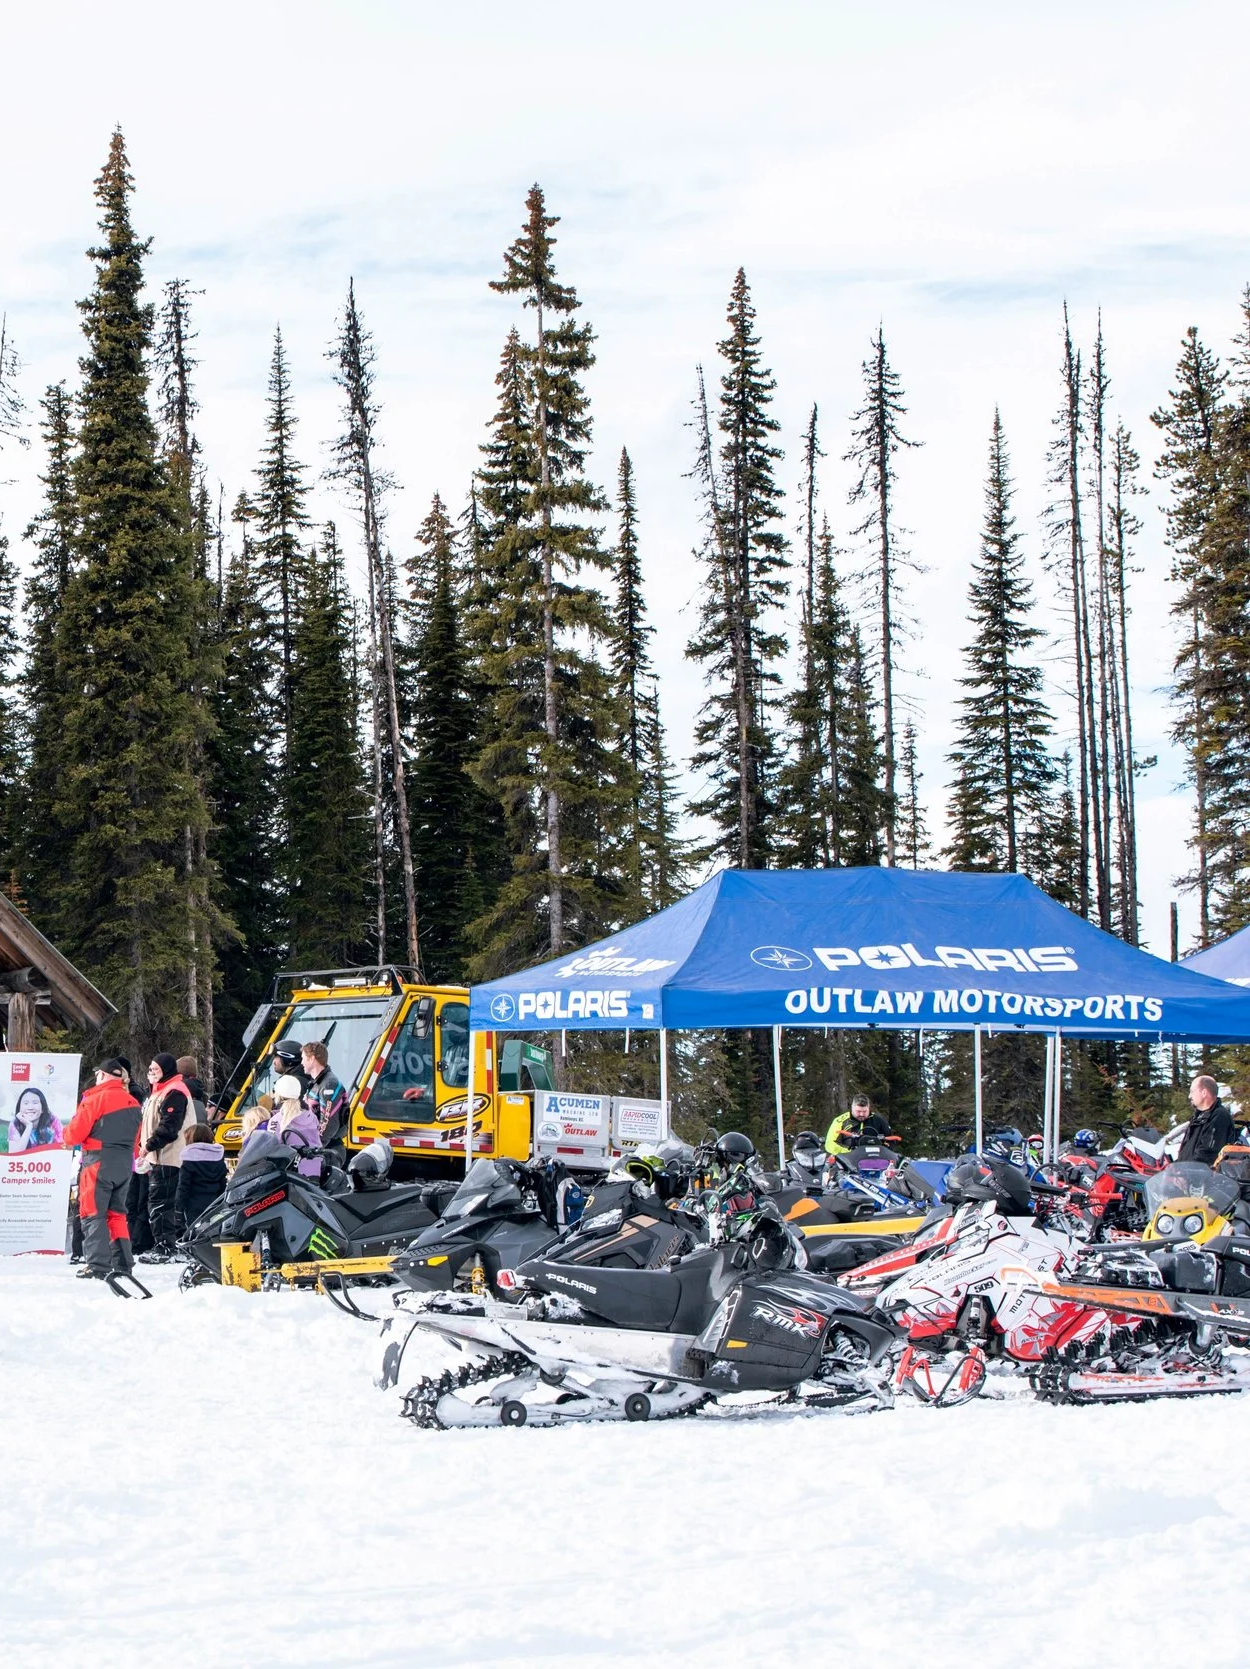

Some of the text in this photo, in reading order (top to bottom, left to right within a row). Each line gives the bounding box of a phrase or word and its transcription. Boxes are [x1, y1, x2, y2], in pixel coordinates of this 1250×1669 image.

[812, 943, 1079, 973] POLARIS
[518, 990, 628, 1020] POLARIS
[784, 987, 1163, 1022] OUTLAW MOTORSPORTS
[546, 1096, 601, 1113] ACUMEN
[565, 1128, 598, 1136] OUTLAW
[8, 1162, 51, 1174] 35,000
[1, 1177, 30, 1185] Camper
[244, 1191, 286, 1217] POLARIS
[546, 1273, 597, 1295] POLARIS
[974, 1281, 994, 1294] 509
[753, 1306, 810, 1340] RMK
